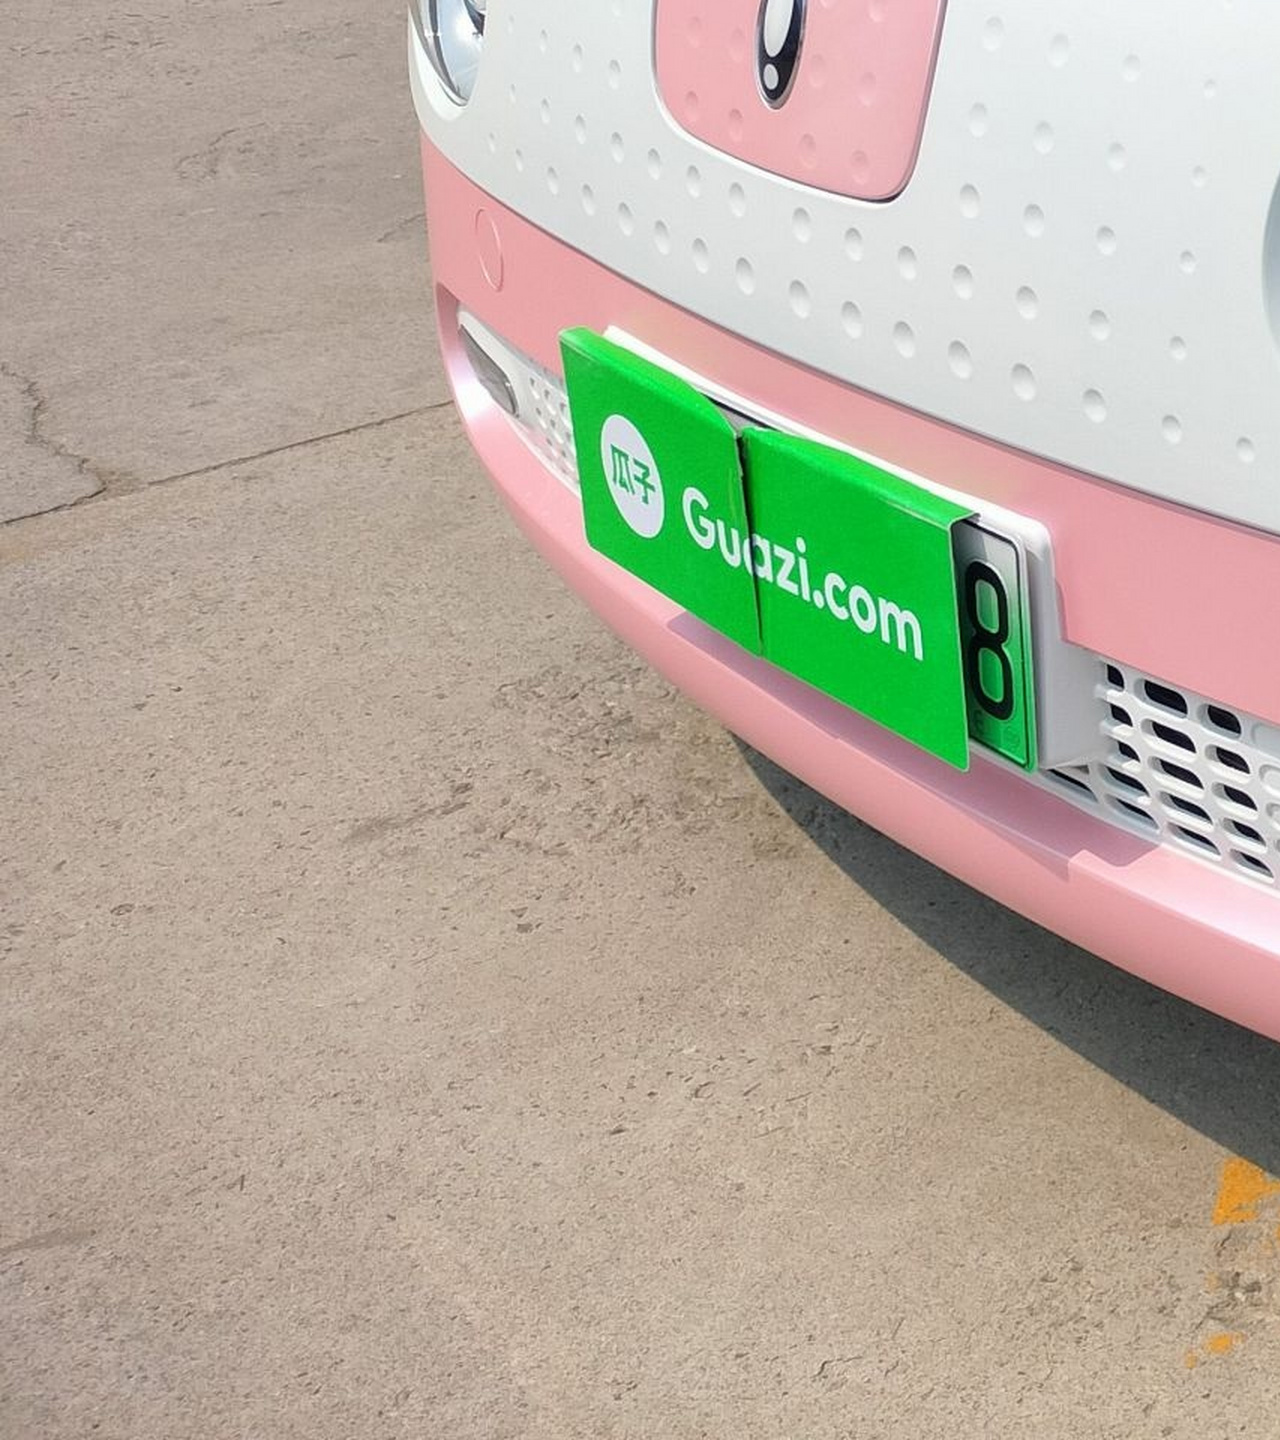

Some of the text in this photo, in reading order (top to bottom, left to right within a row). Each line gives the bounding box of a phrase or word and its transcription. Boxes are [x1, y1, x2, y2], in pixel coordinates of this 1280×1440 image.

[610, 443, 656, 505] 瓜子
[682, 486, 924, 662] Guazi.com
[965, 560, 1015, 721] 8
